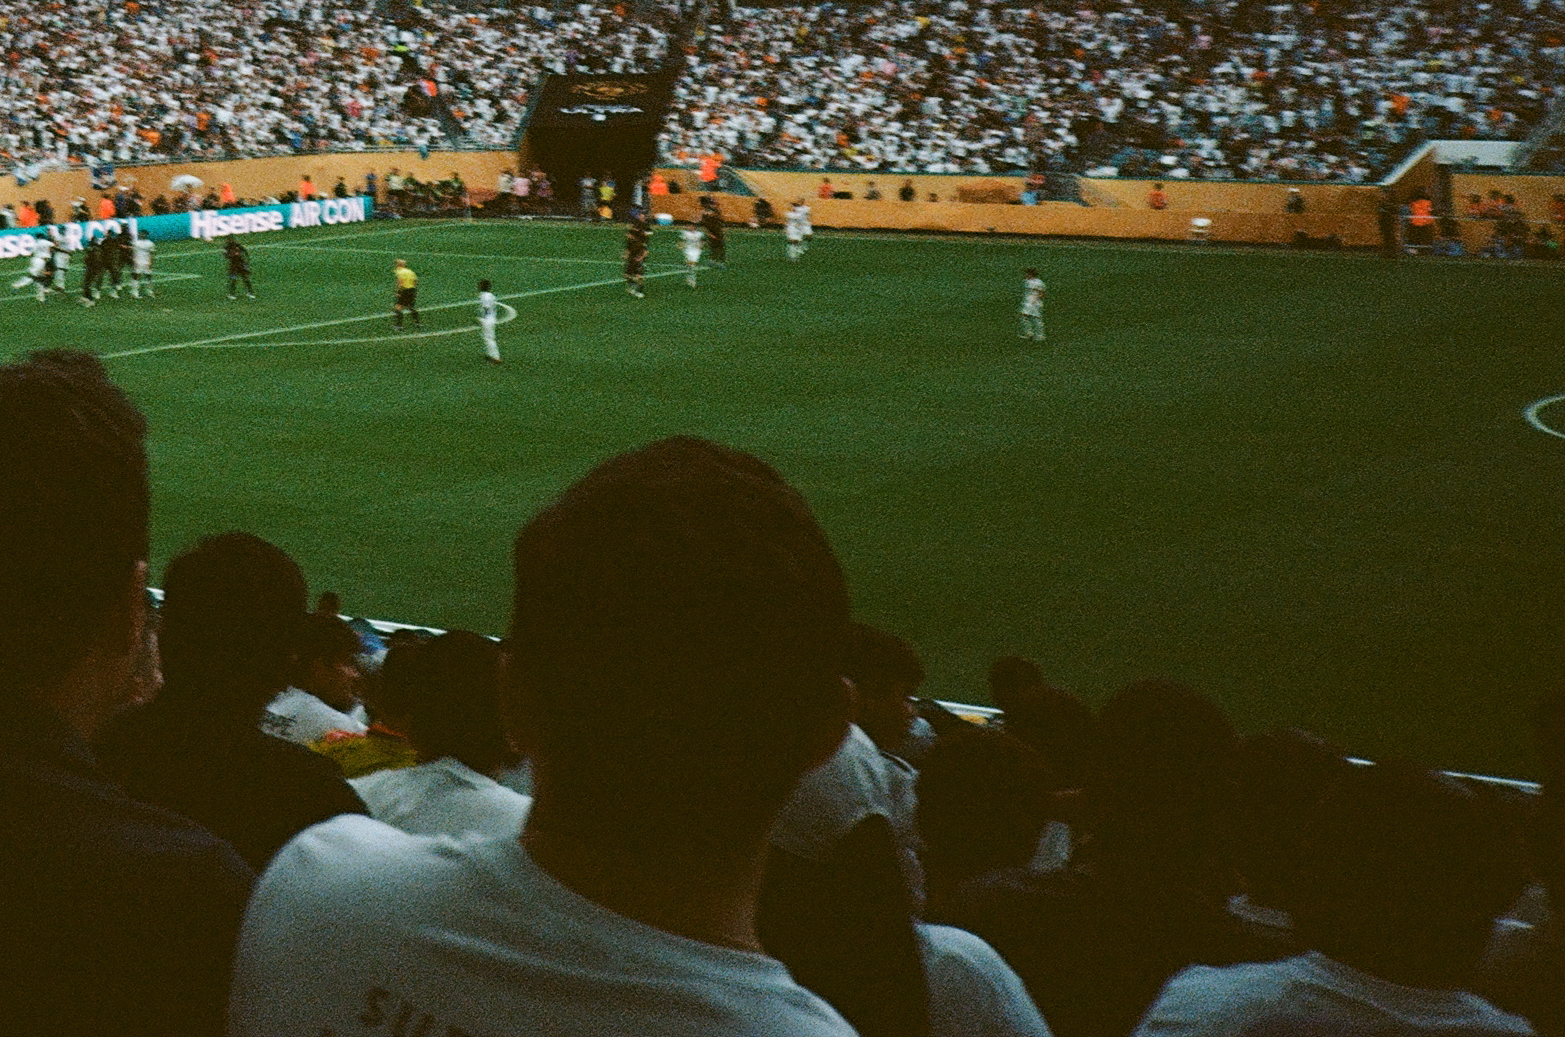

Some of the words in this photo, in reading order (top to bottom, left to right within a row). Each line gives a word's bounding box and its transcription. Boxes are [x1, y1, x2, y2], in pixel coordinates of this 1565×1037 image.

[189, 210, 284, 240] Hisense
[289, 202, 321, 227] AIR
[324, 196, 365, 224] CON
